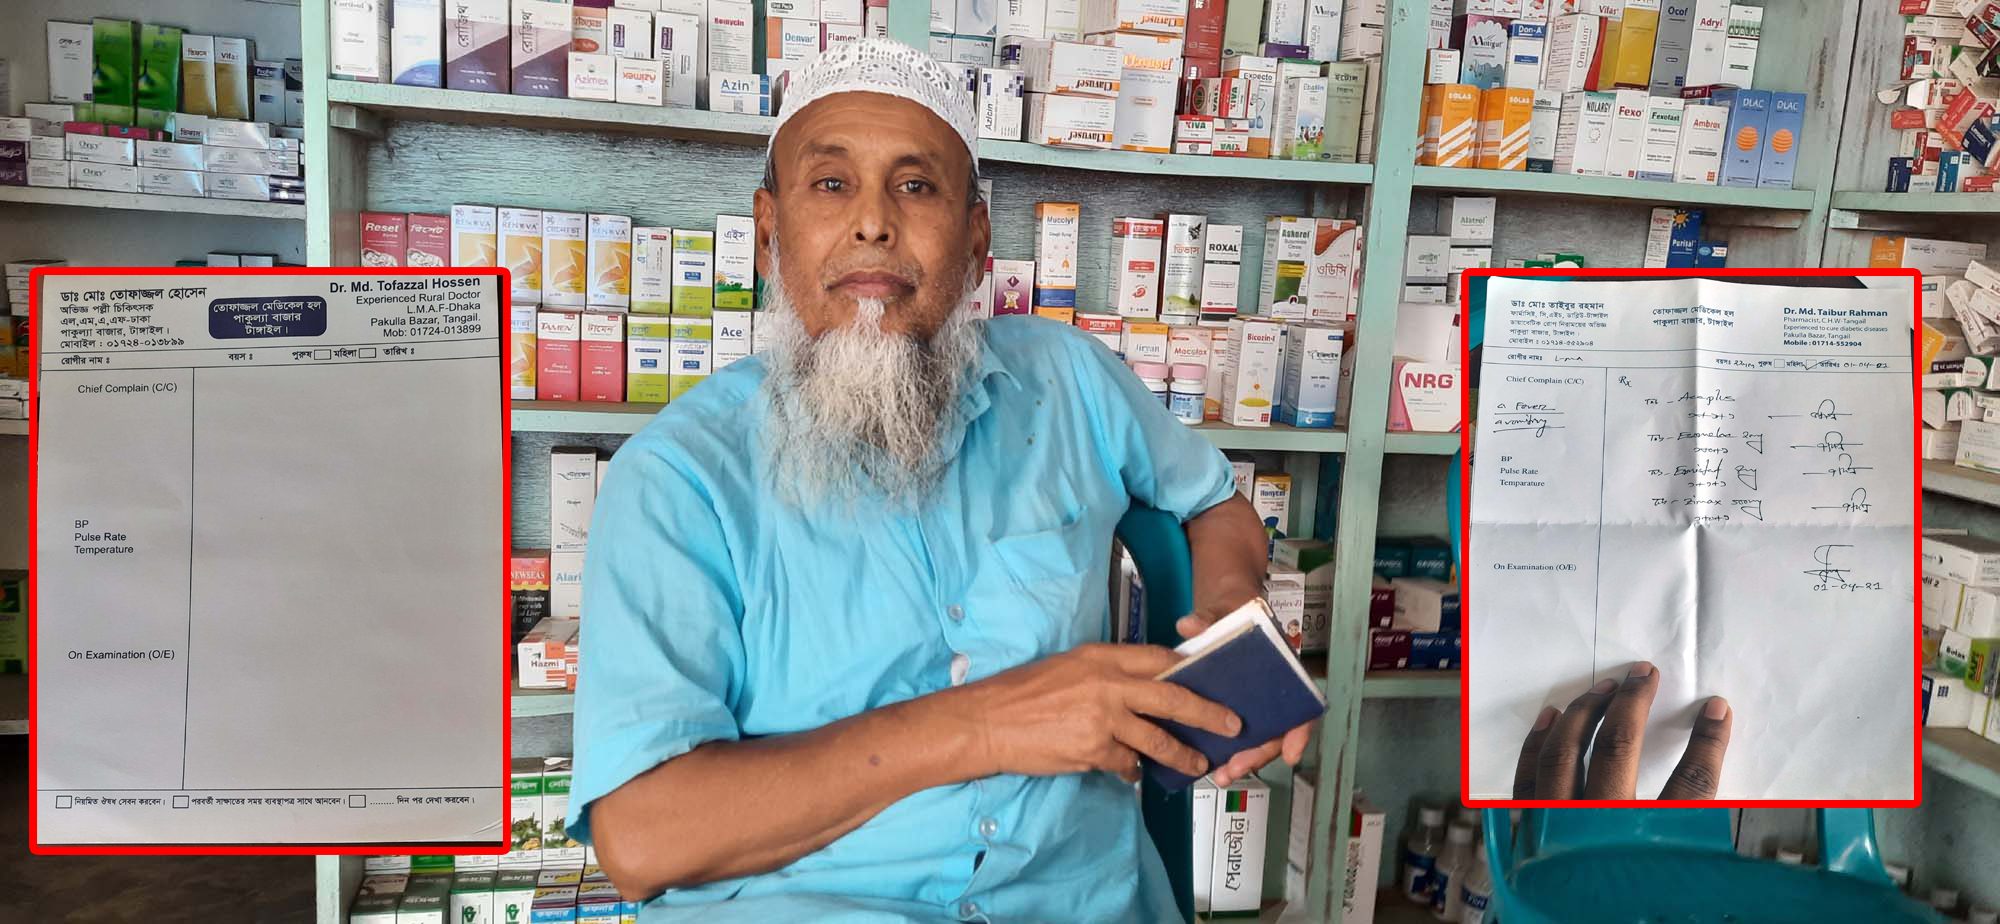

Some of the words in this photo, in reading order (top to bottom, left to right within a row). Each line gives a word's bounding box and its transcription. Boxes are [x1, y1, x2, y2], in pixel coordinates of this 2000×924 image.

[1518, 26, 1542, 34] Don-A
[721, 79, 749, 91] Azin
[1743, 98, 1765, 109] DLAC
[1777, 100, 1799, 111] DLAC
[1618, 106, 1642, 118] Fexo
[1693, 119, 1721, 129] Ambrox
[365, 222, 400, 233] Reset
[1209, 243, 1239, 252] ROXAL
[329, 282, 347, 293] Dr.
[351, 281, 373, 293] Md.
[377, 279, 428, 291] Tofazzal
[432, 277, 481, 289] Hossen
[60, 290, 79, 302] ডাঃ
[83, 290, 105, 302] মোঃ
[110, 288, 164, 301] তোফাজ্জল
[168, 287, 207, 299] হোসেন
[356, 294, 416, 306] Experienced
[419, 293, 446, 303] Rural
[449, 291, 481, 301] Doctor
[60, 305, 89, 315] অভিজ্ঞ
[93, 303, 110, 315] পল্লী
[113, 303, 154, 313] চিকিৎসক
[213, 302, 259, 314] তোফাজ্জল
[262, 299, 303, 311] মেডিকেল
[307, 301, 322, 311] হল
[407, 302, 481, 314] L.M.A.F-Dhaka
[1548, 301, 1575, 310] তাইবুর
[1578, 302, 1604, 310] রহমান
[1652, 307, 1688, 315] তোফাজ্জল
[1690, 305, 1721, 316] মেডিকেল
[1724, 309, 1735, 317] হল
[272, 312, 302, 323] বাজার
[1783, 307, 1797, 315] Dr.
[1798, 308, 1816, 316] Md.
[1817, 308, 1847, 317] Taibur
[1849, 309, 1888, 317] Rahman
[371, 316, 406, 327] Pakulla
[409, 315, 440, 327] Bazar,
[443, 313, 481, 325] Tangail.
[383, 328, 407, 338] Mob:
[410, 324, 481, 337] 01724-013899
[720, 327, 743, 337] Ace
[1828, 332, 1850, 340] Tangail
[106, 338, 185, 348] ০১৭২৪-০১৩৮৯৯
[333, 348, 357, 358] মহিলা
[61, 355, 86, 365] রোগীর
[1404, 373, 1454, 389] NRG
[1528, 376, 1563, 385] Complain
[1564, 378, 1585, 386] (C/C)
[78, 384, 103, 394] Chief
[105, 383, 149, 395] Complain
[152, 382, 178, 393] (C/C)
[1500, 467, 1520, 475] Pulse
[74, 520, 89, 529] BP
[74, 532, 101, 542] Pulse
[104, 532, 127, 542] Rate
[74, 545, 134, 555] Temperature
[1507, 563, 1554, 571] Examination
[1556, 564, 1577, 572] (O/E)
[68, 650, 83, 660] On
[85, 650, 146, 660] Examination
[148, 649, 175, 661] (O/E)
[396, 795, 410, 804] দিন
[426, 796, 442, 804] দেখা
